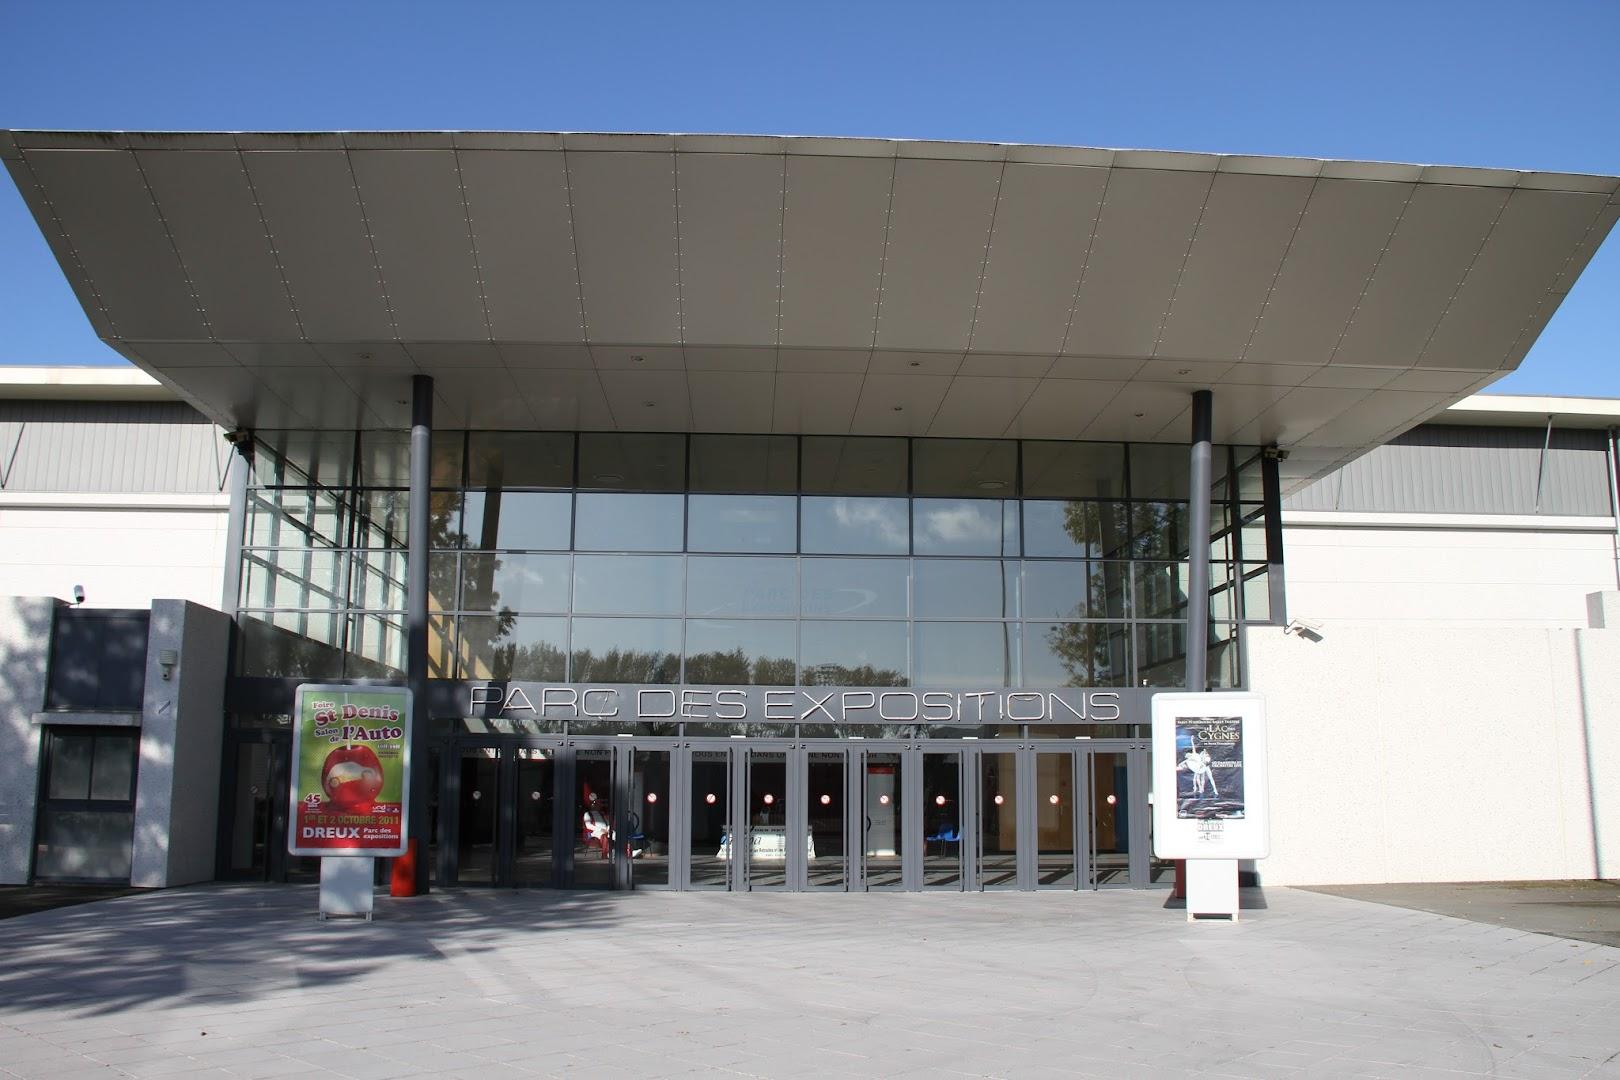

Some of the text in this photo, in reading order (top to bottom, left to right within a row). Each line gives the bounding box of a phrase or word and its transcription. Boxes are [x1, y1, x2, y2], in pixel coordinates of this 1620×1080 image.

[313, 702, 334, 710] Foire
[470, 686, 1120, 722] PARC DES EXPOSITIONS
[315, 704, 399, 726] St Denis
[315, 728, 338, 736] Salon
[342, 726, 402, 741] l'Auto
[1209, 725, 1228, 733] LAC
[1198, 731, 1240, 740] CYGNES
[305, 793, 321, 804] 45
[318, 815, 327, 825] ET
[329, 815, 336, 825] 2
[338, 815, 377, 825] OCTOBRE
[379, 815, 399, 825] 2011
[302, 826, 360, 839] DREUX
